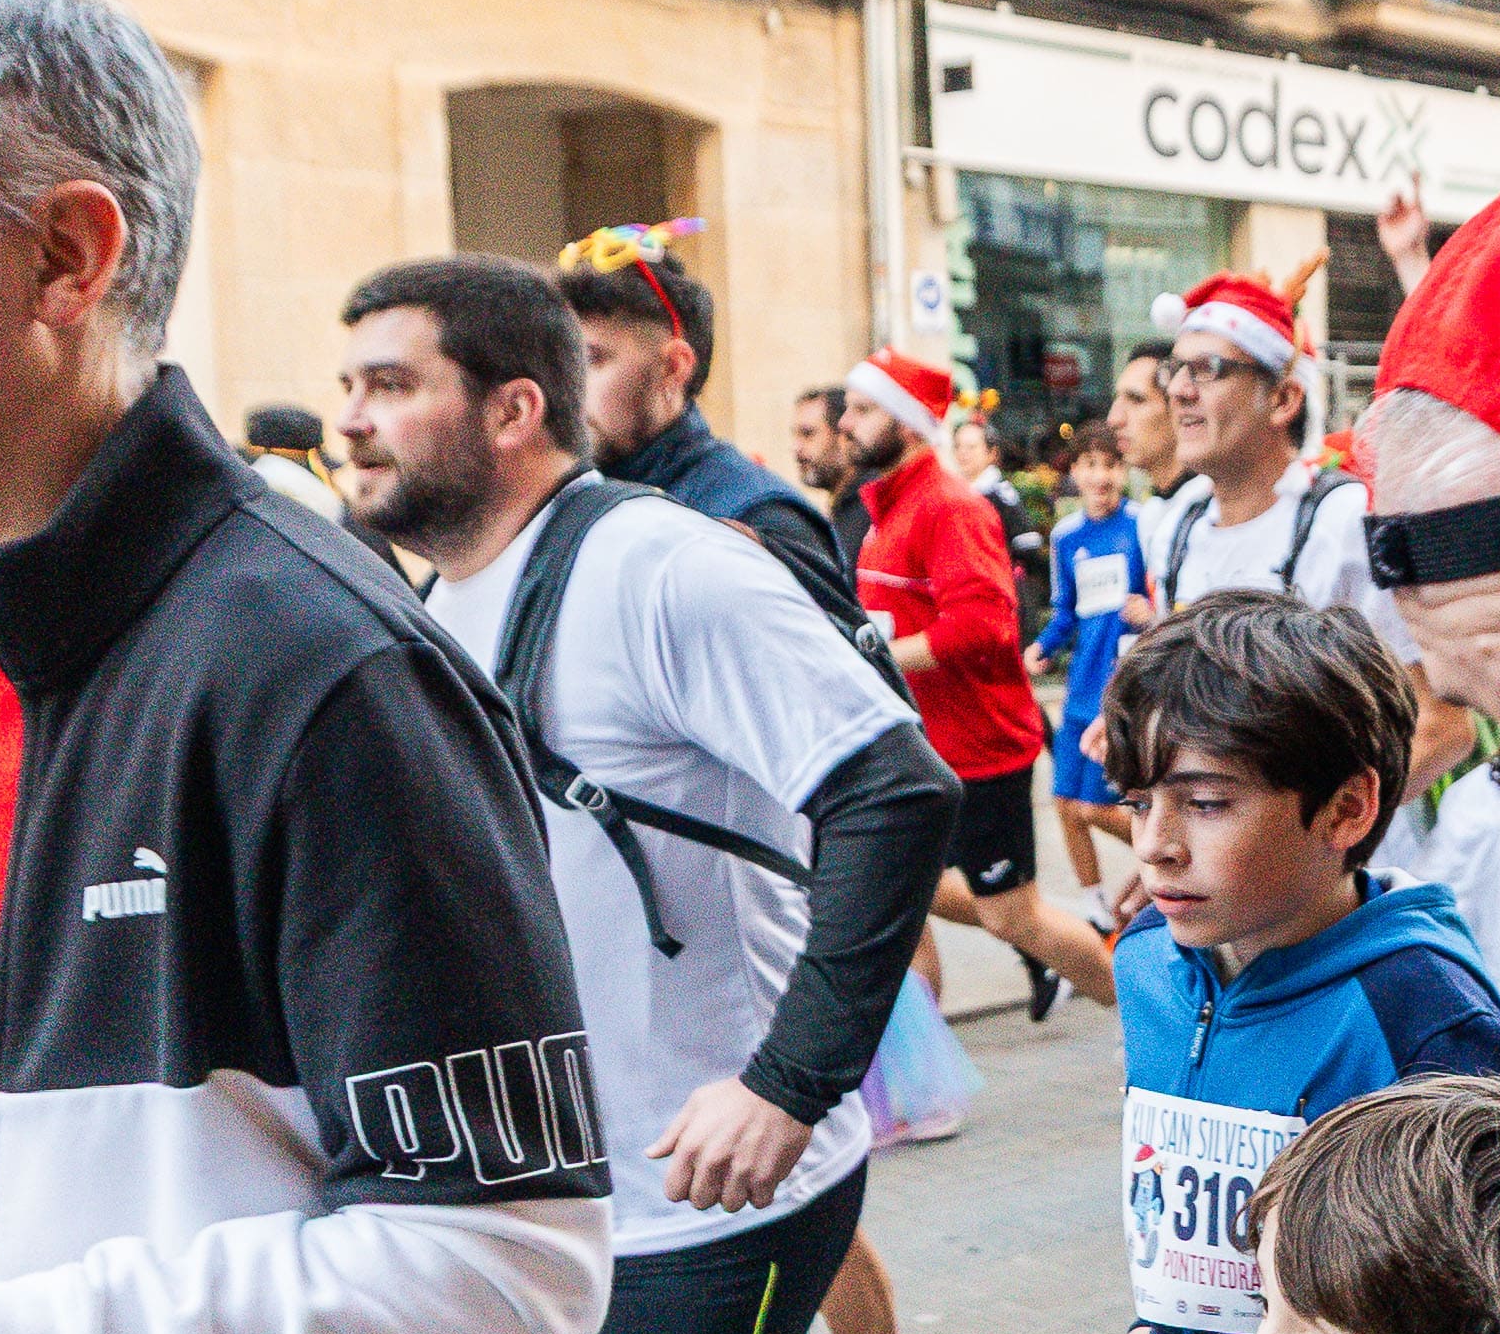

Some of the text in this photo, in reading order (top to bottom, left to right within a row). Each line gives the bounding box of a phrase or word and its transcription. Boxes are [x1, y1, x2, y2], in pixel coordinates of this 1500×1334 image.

[1143, 77, 1366, 180] codex
[1160, 1108, 1193, 1158] SAN
[1162, 1248, 1261, 1292] PONTEVEDRA
